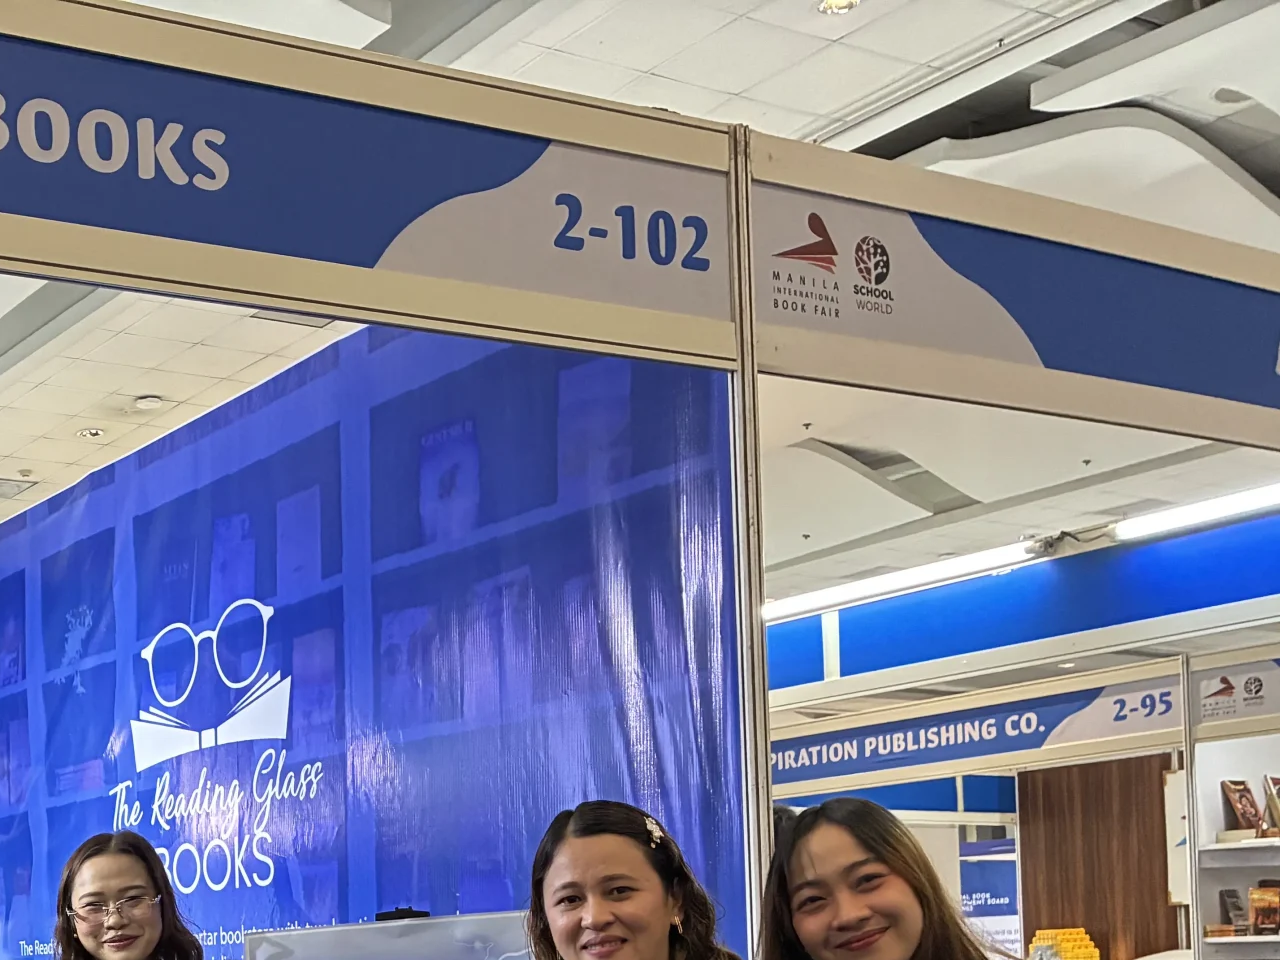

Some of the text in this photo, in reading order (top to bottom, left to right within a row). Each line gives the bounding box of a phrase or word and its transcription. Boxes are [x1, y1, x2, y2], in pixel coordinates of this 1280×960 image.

[553, 193, 711, 272] 2-102
[772, 270, 840, 291] MANILA
[773, 286, 839, 305] INTERNATIONAL
[853, 284, 895, 301] SCHOOL
[773, 298, 840, 319] BOOK FAIR
[856, 299, 893, 315] WORLD
[1113, 691, 1173, 722] 2-95
[864, 718, 997, 758] PUBLISHING
[1005, 712, 1046, 737] CO.
[109, 748, 324, 839] The Reading Glass
[19, 940, 33, 956] The
